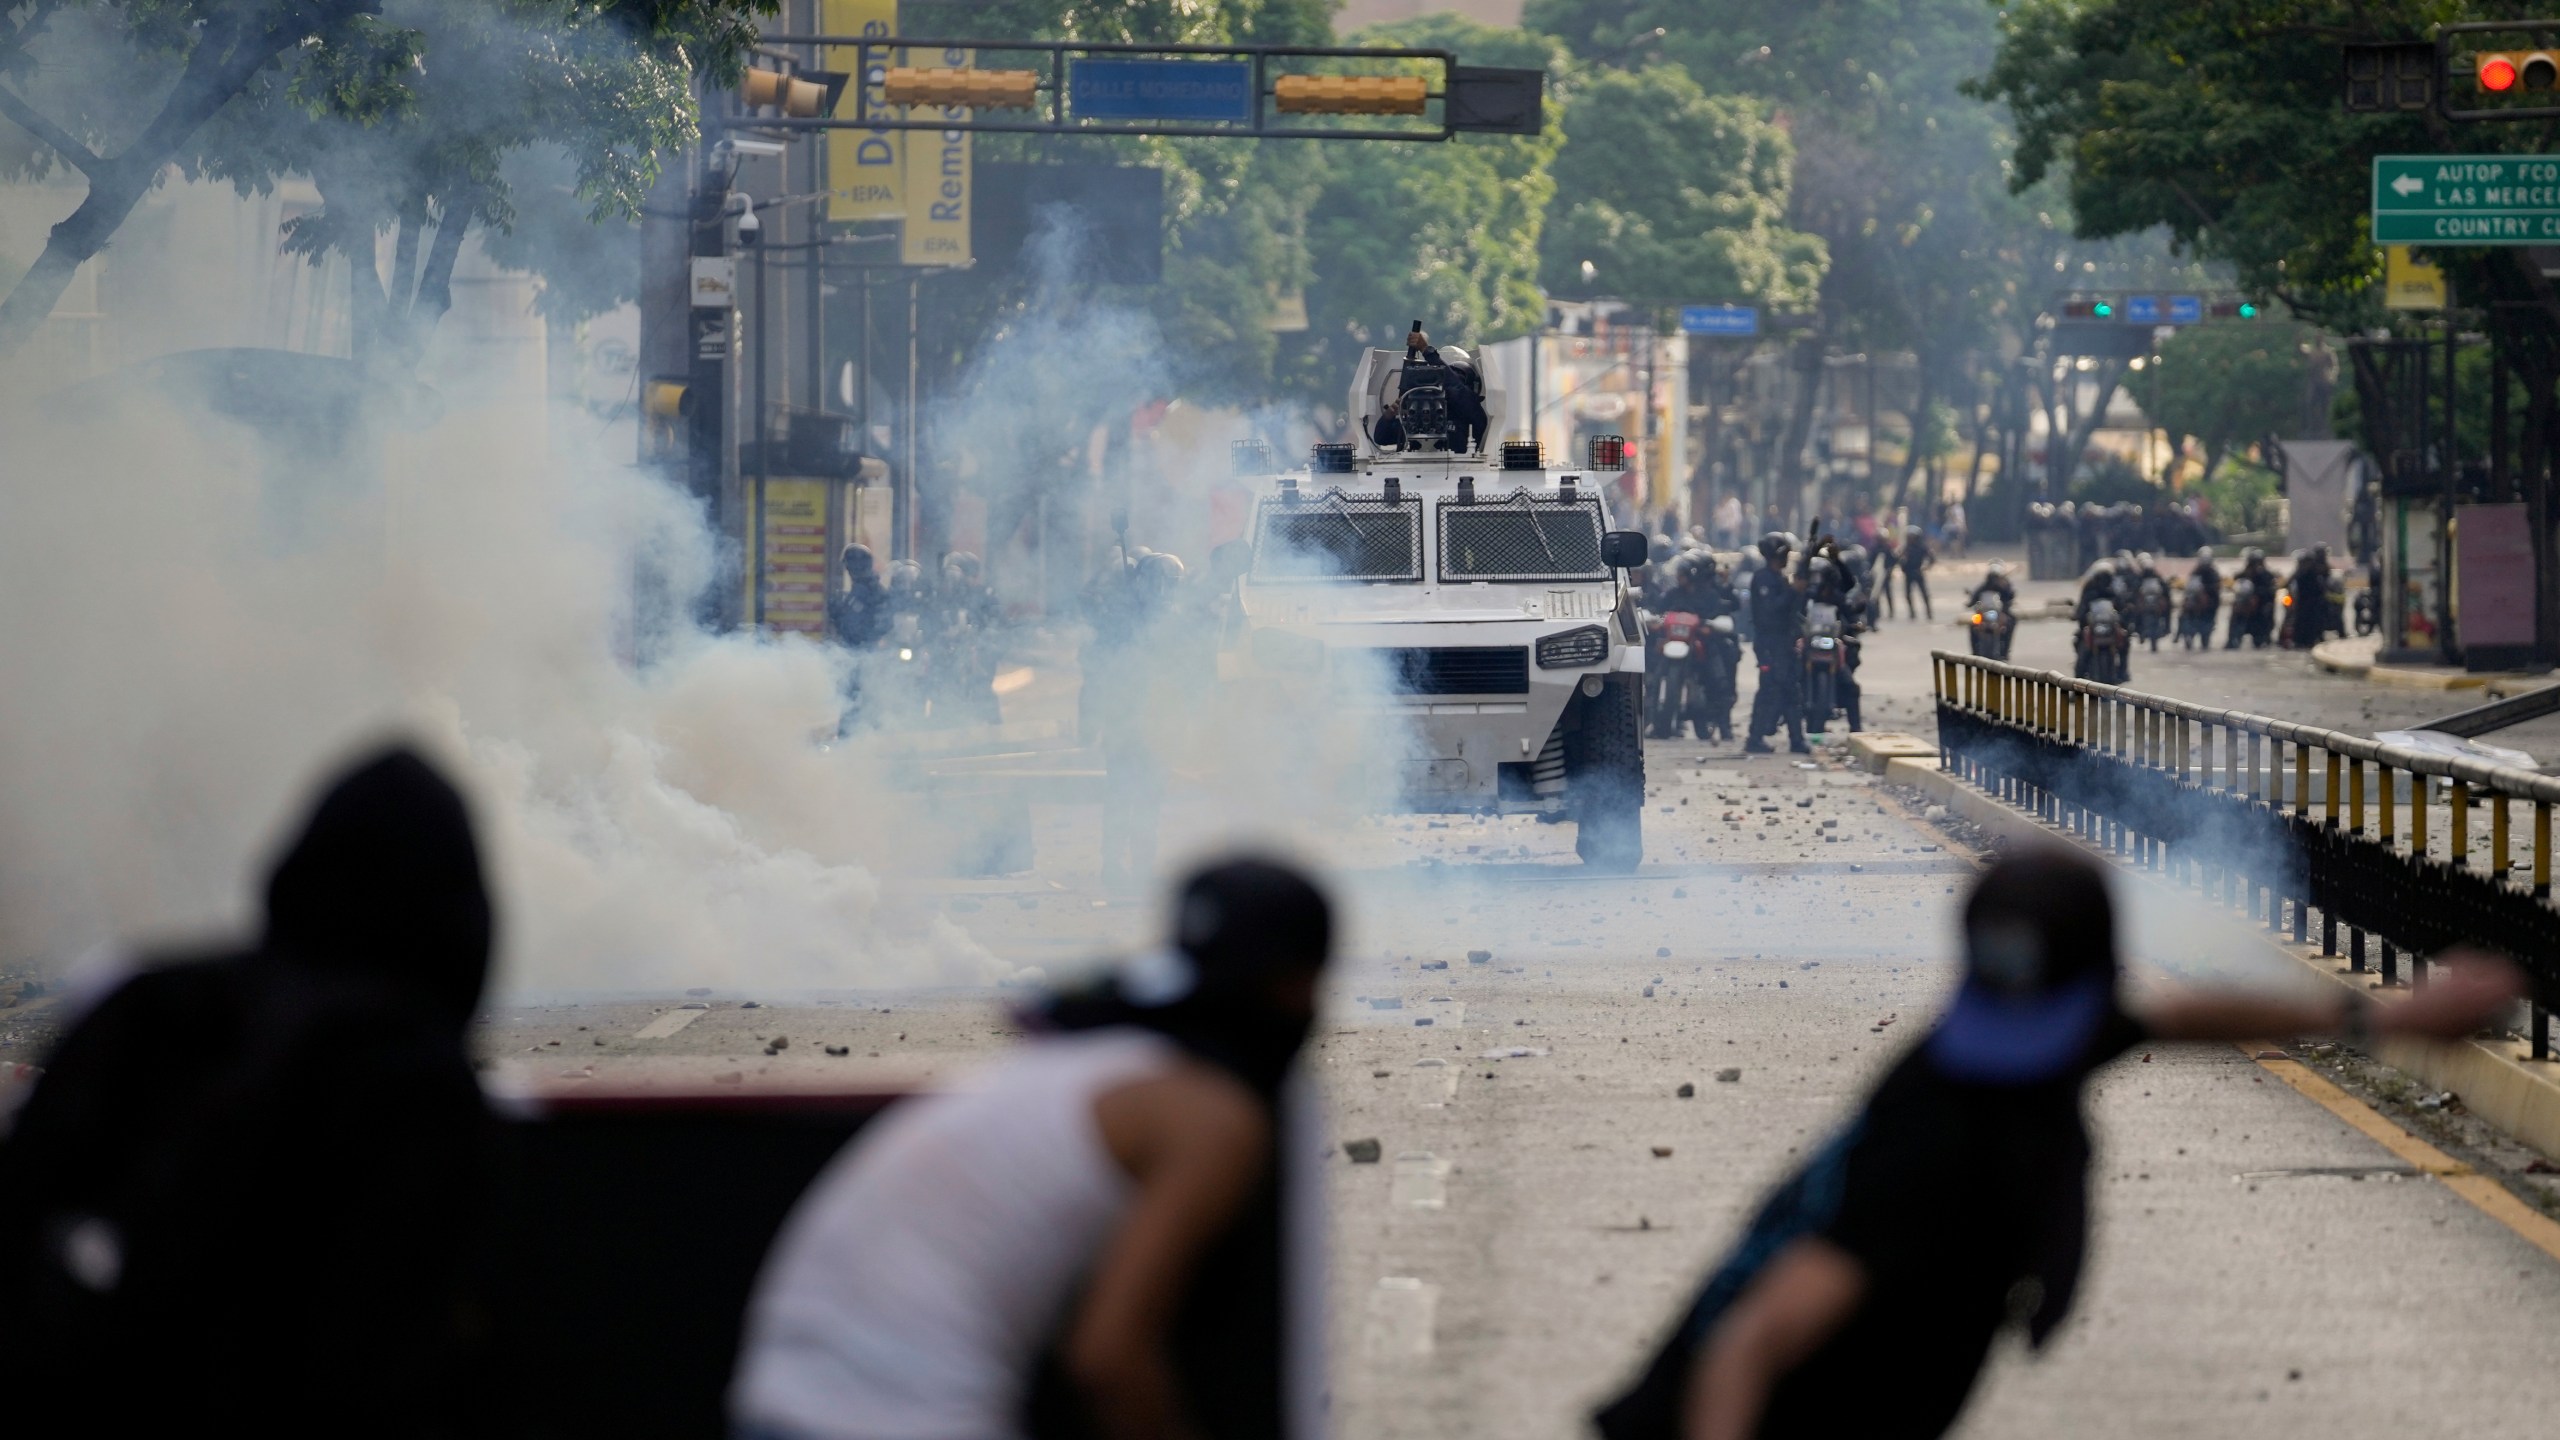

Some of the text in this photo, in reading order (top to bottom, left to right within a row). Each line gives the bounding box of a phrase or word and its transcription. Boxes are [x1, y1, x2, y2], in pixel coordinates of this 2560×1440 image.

[1078, 80, 1135, 98] CALLE
[2434, 186, 2477, 206] LAS
[2434, 216, 2532, 237] COUNTRY
